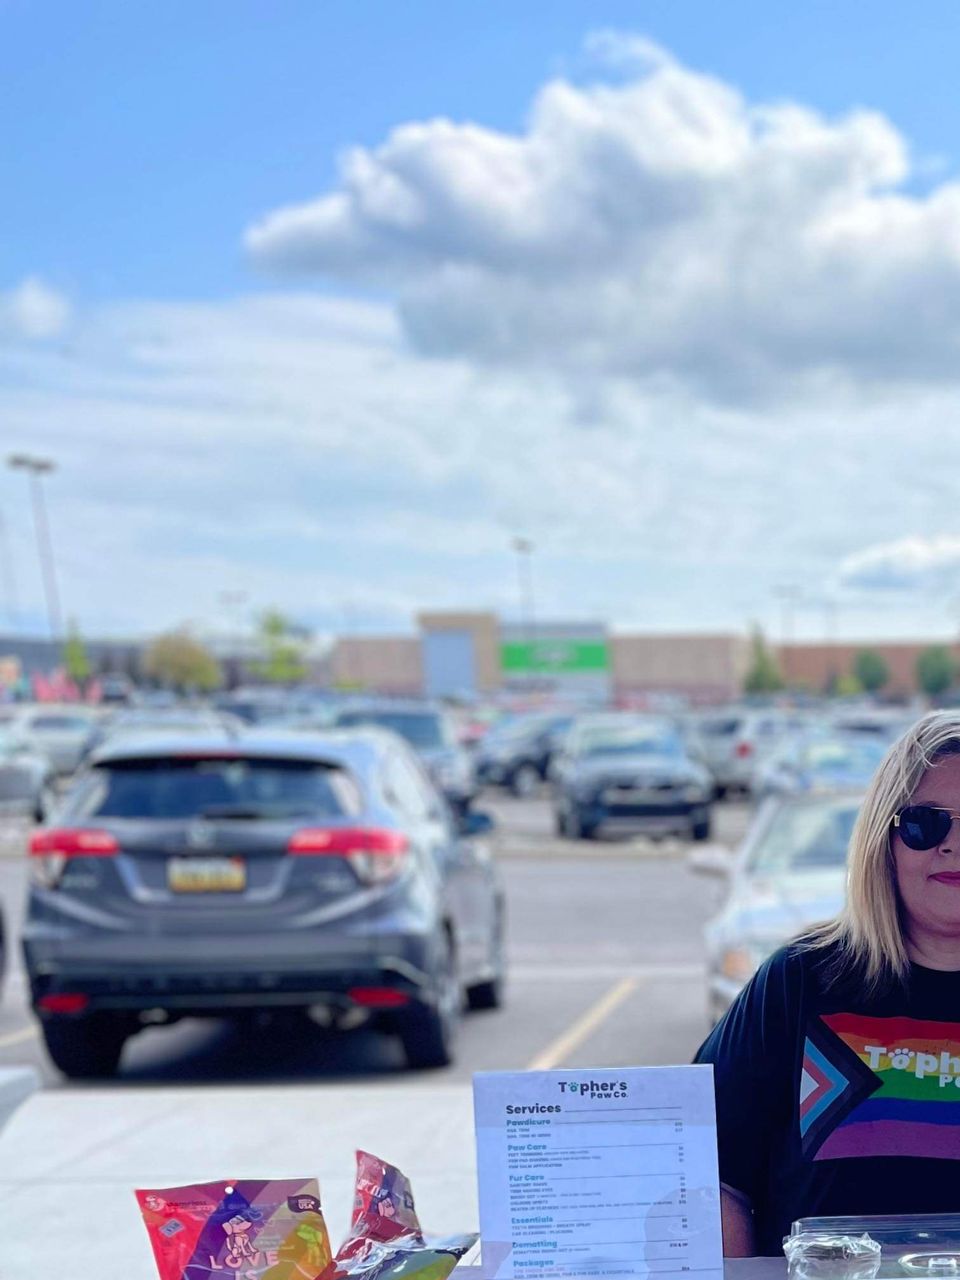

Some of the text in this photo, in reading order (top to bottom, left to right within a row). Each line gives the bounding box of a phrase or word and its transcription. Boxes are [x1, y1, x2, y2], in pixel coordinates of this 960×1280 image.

[558, 1080, 627, 1096] Topher's
[506, 1103, 561, 1114] Services
[506, 1118, 551, 1127] Pawdicure
[527, 1143, 547, 1151] Care
[511, 1216, 553, 1224] Essentials
[209, 1250, 280, 1269] LOVE
[513, 1260, 554, 1268] Packages
